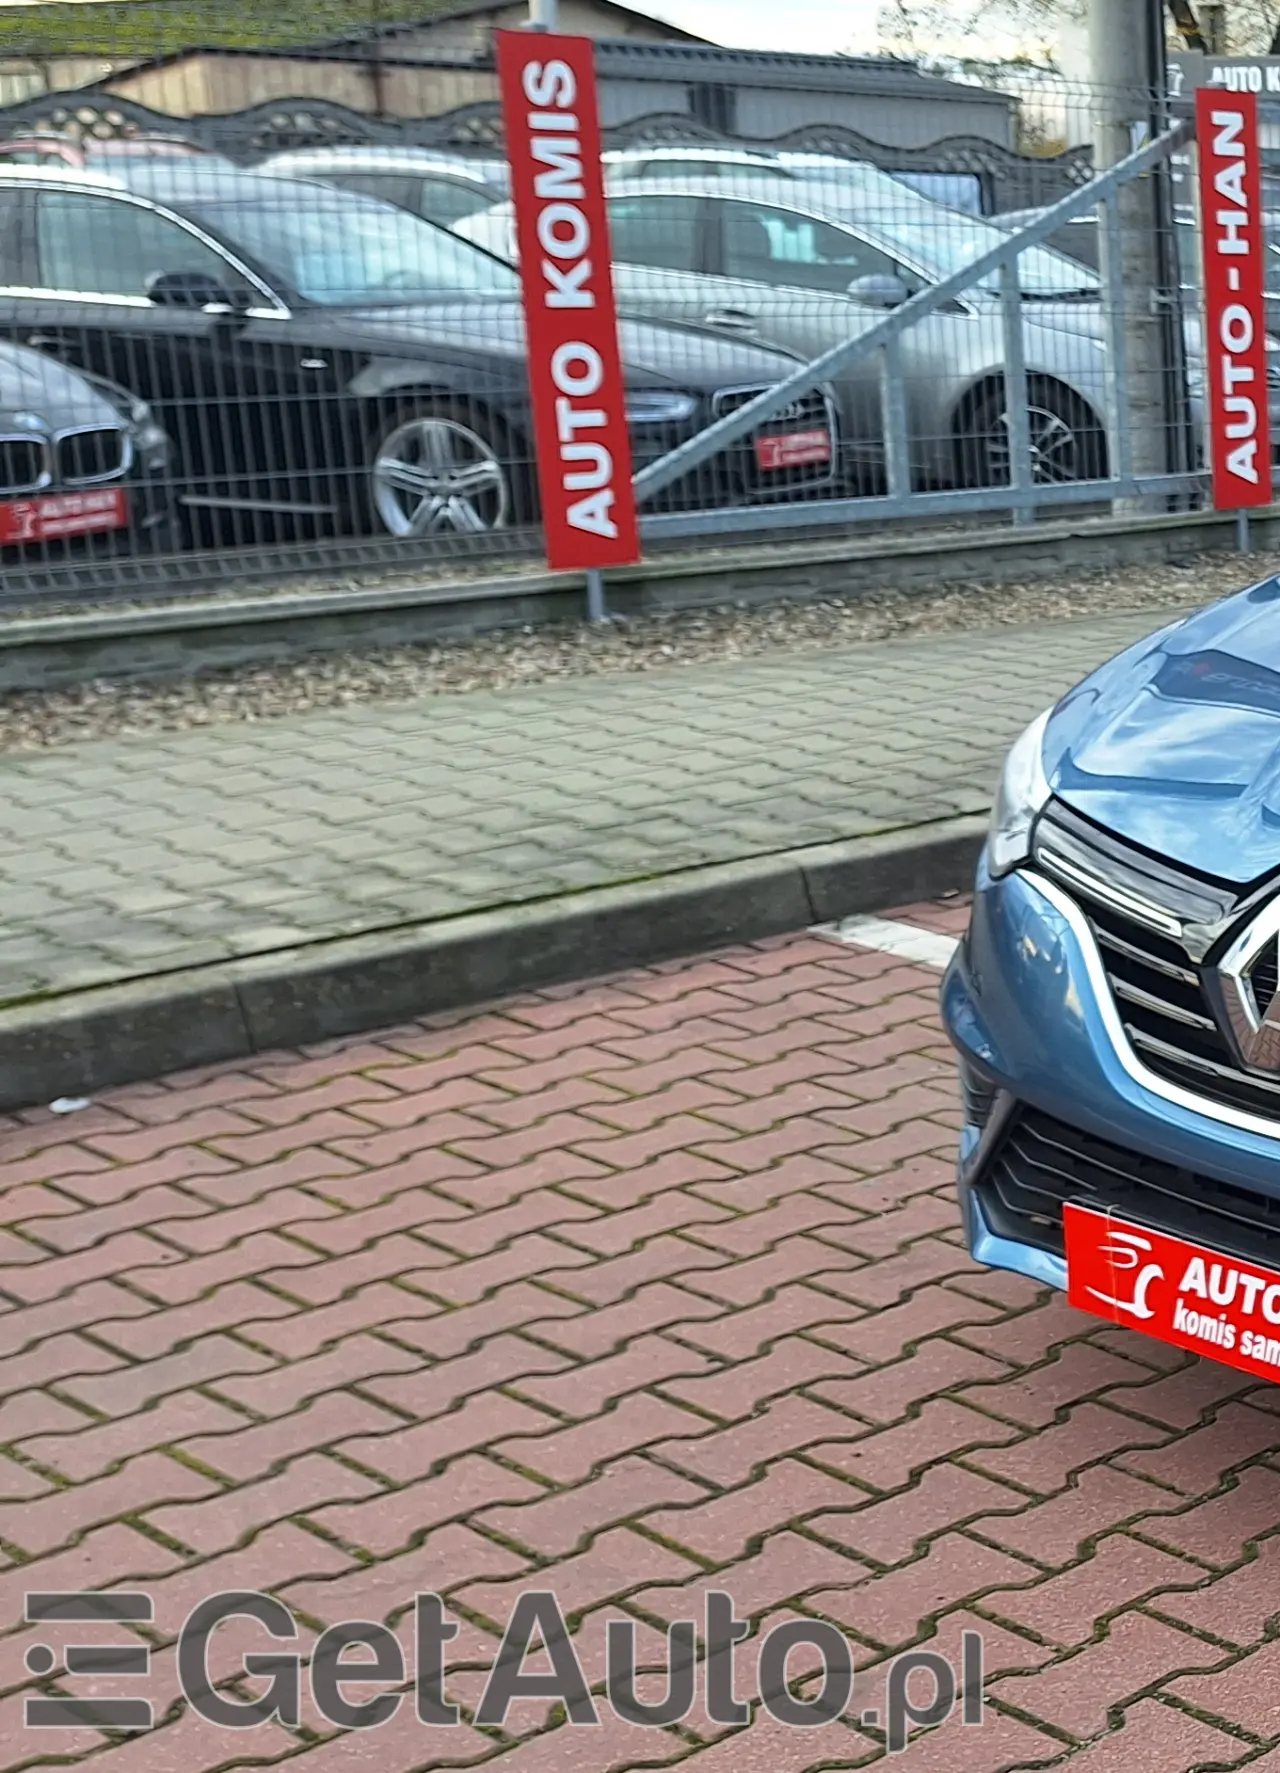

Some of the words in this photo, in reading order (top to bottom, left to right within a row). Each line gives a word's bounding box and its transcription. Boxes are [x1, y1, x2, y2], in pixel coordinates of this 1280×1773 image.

[1210, 65, 1263, 93] AUTO
[521, 58, 596, 310] KOMIS
[550, 340, 620, 540] AUTO
[1172, 1297, 1236, 1350] komis
